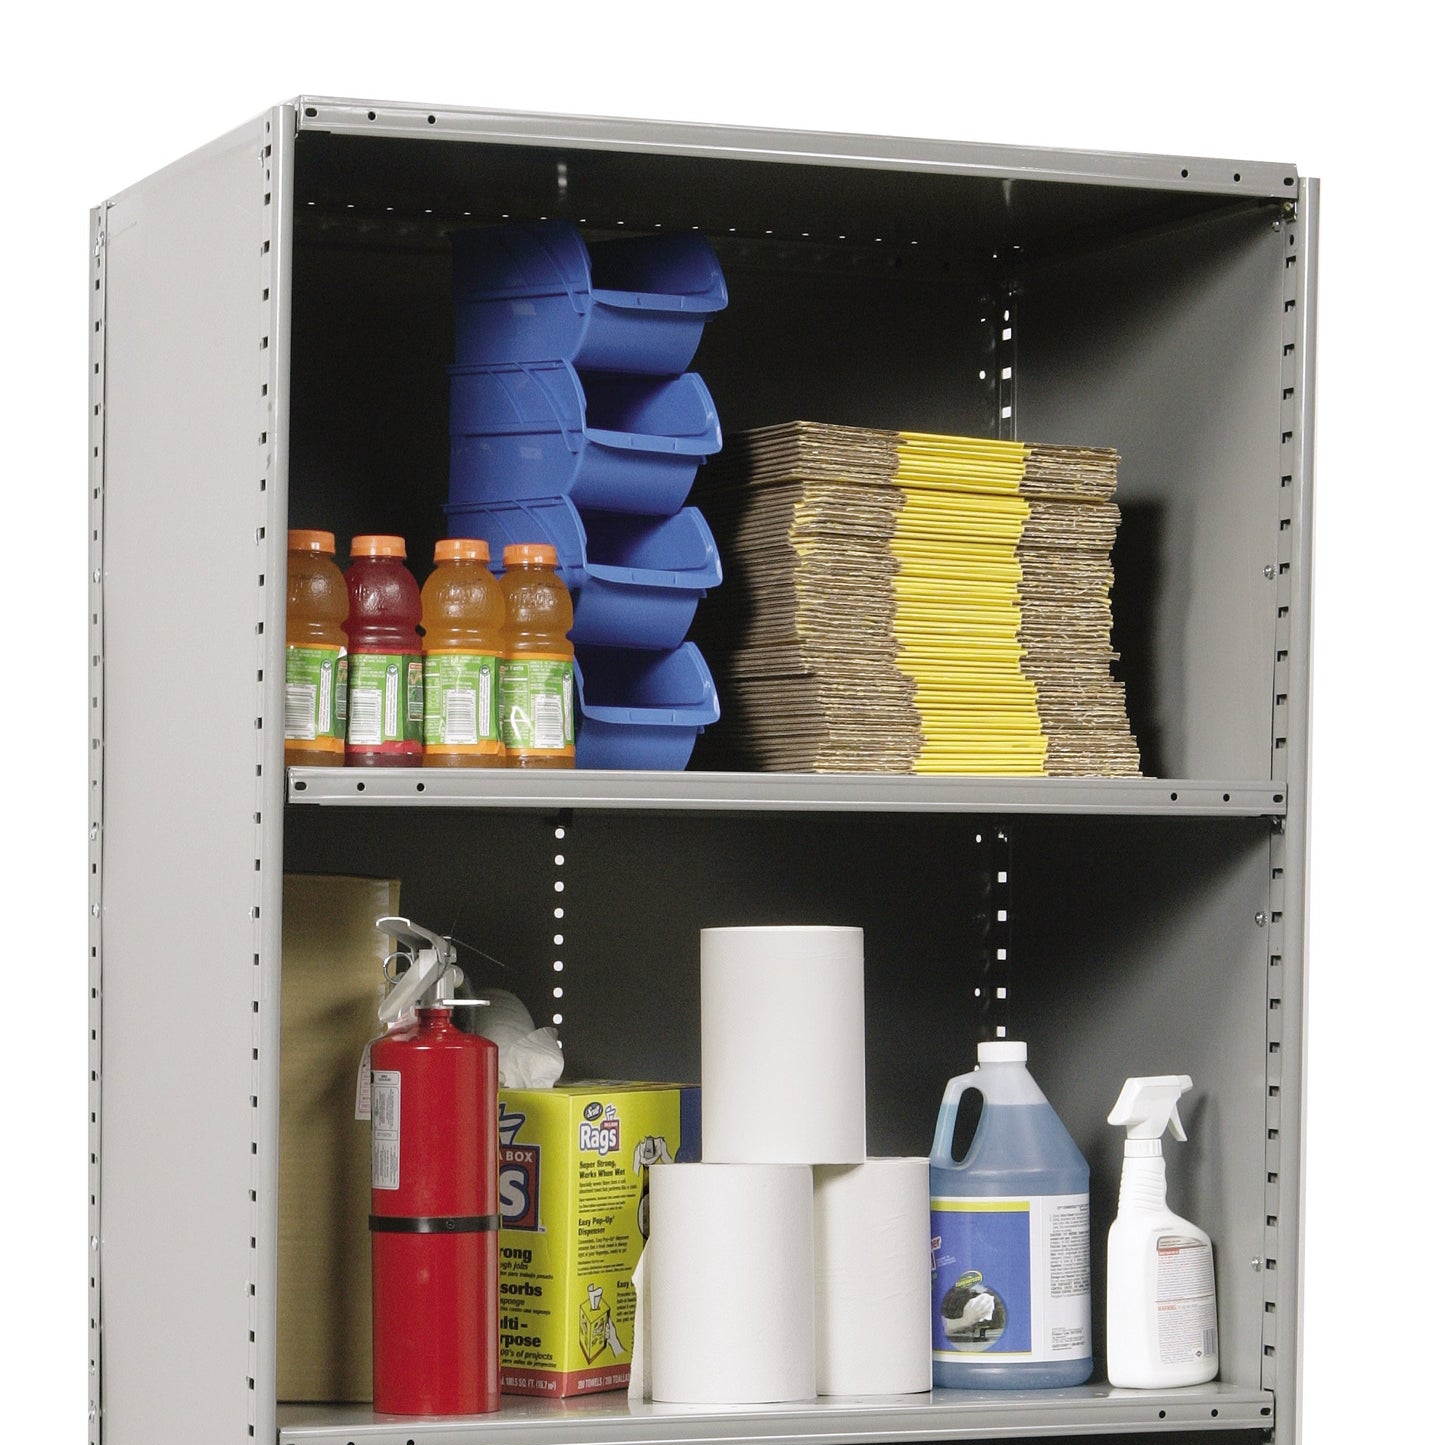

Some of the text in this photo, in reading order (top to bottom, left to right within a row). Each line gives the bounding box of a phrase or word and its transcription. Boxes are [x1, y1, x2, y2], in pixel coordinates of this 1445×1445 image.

[580, 1123, 617, 1156] Rags
[506, 1151, 533, 1162] BOX
[579, 1228, 605, 1236] Dispenser
[525, 1351, 552, 1361] projects
[586, 1377, 602, 1388] TOWELS
